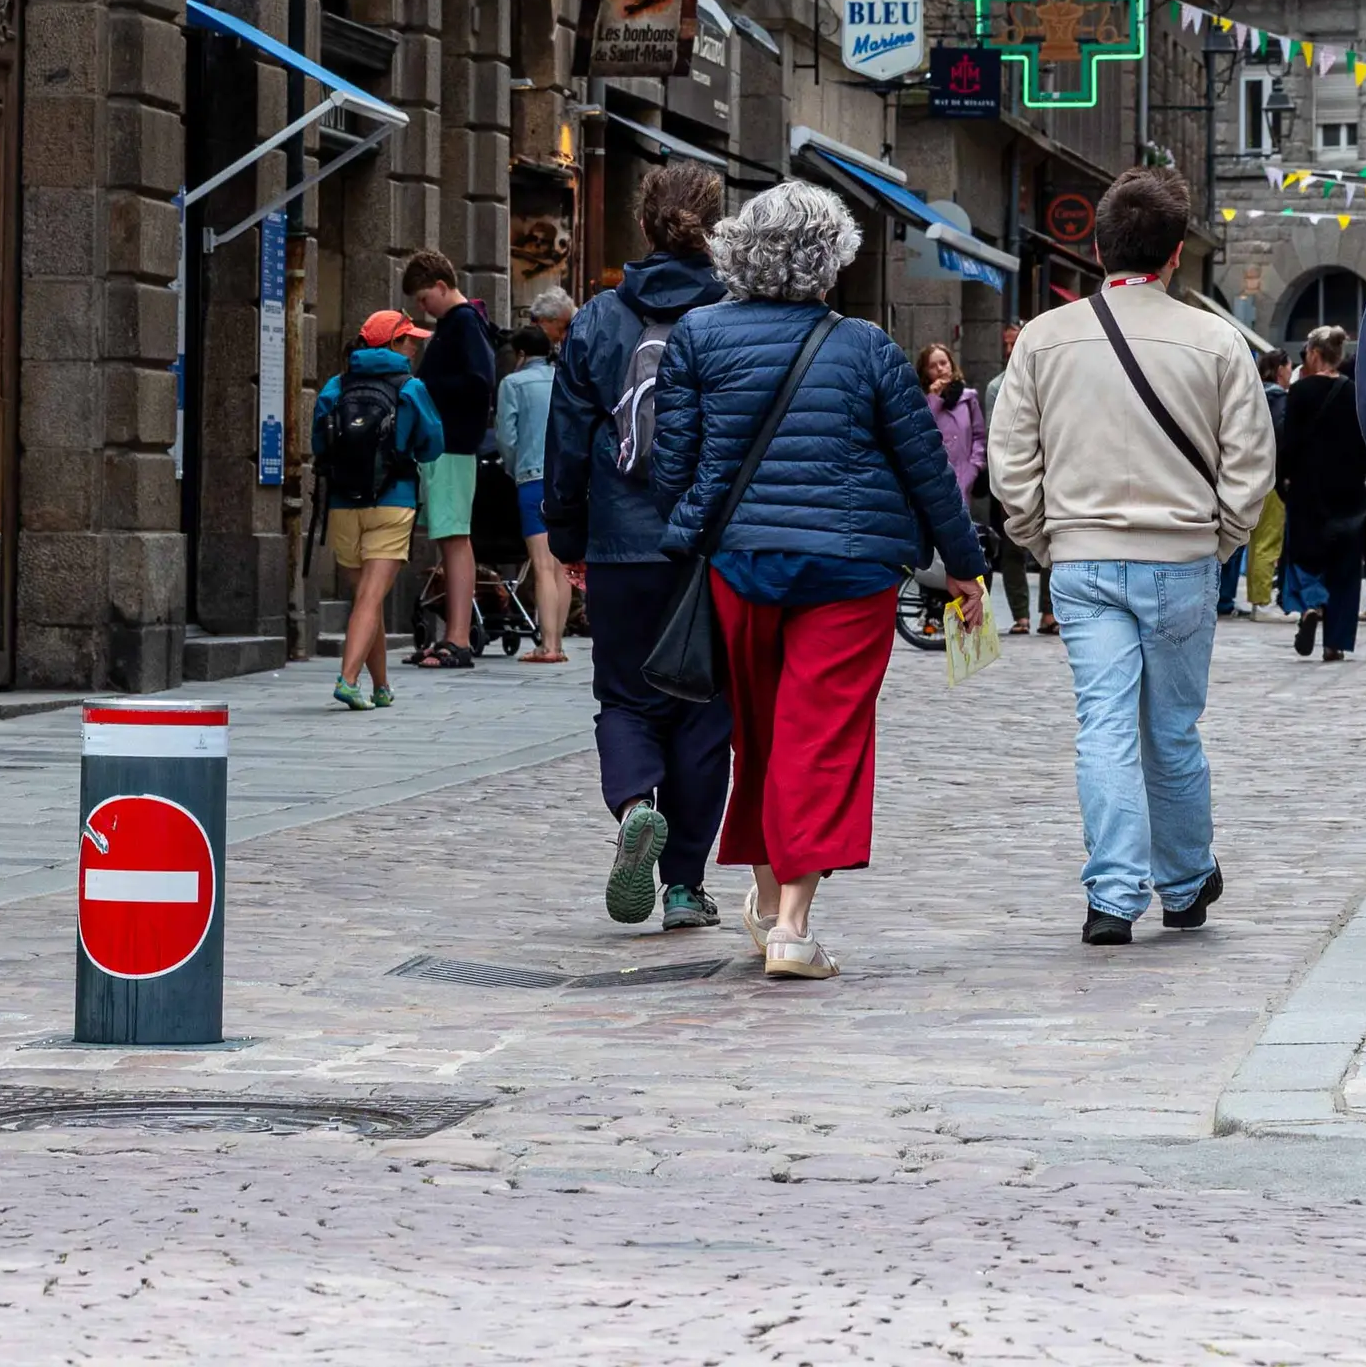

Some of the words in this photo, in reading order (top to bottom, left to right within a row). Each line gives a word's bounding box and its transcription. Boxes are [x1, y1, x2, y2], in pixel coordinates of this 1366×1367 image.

[848, 1, 918, 25] BLEU
[598, 24, 621, 42] Les
[623, 23, 676, 42] bonbons
[851, 31, 915, 57] Marine
[595, 48, 607, 62] de
